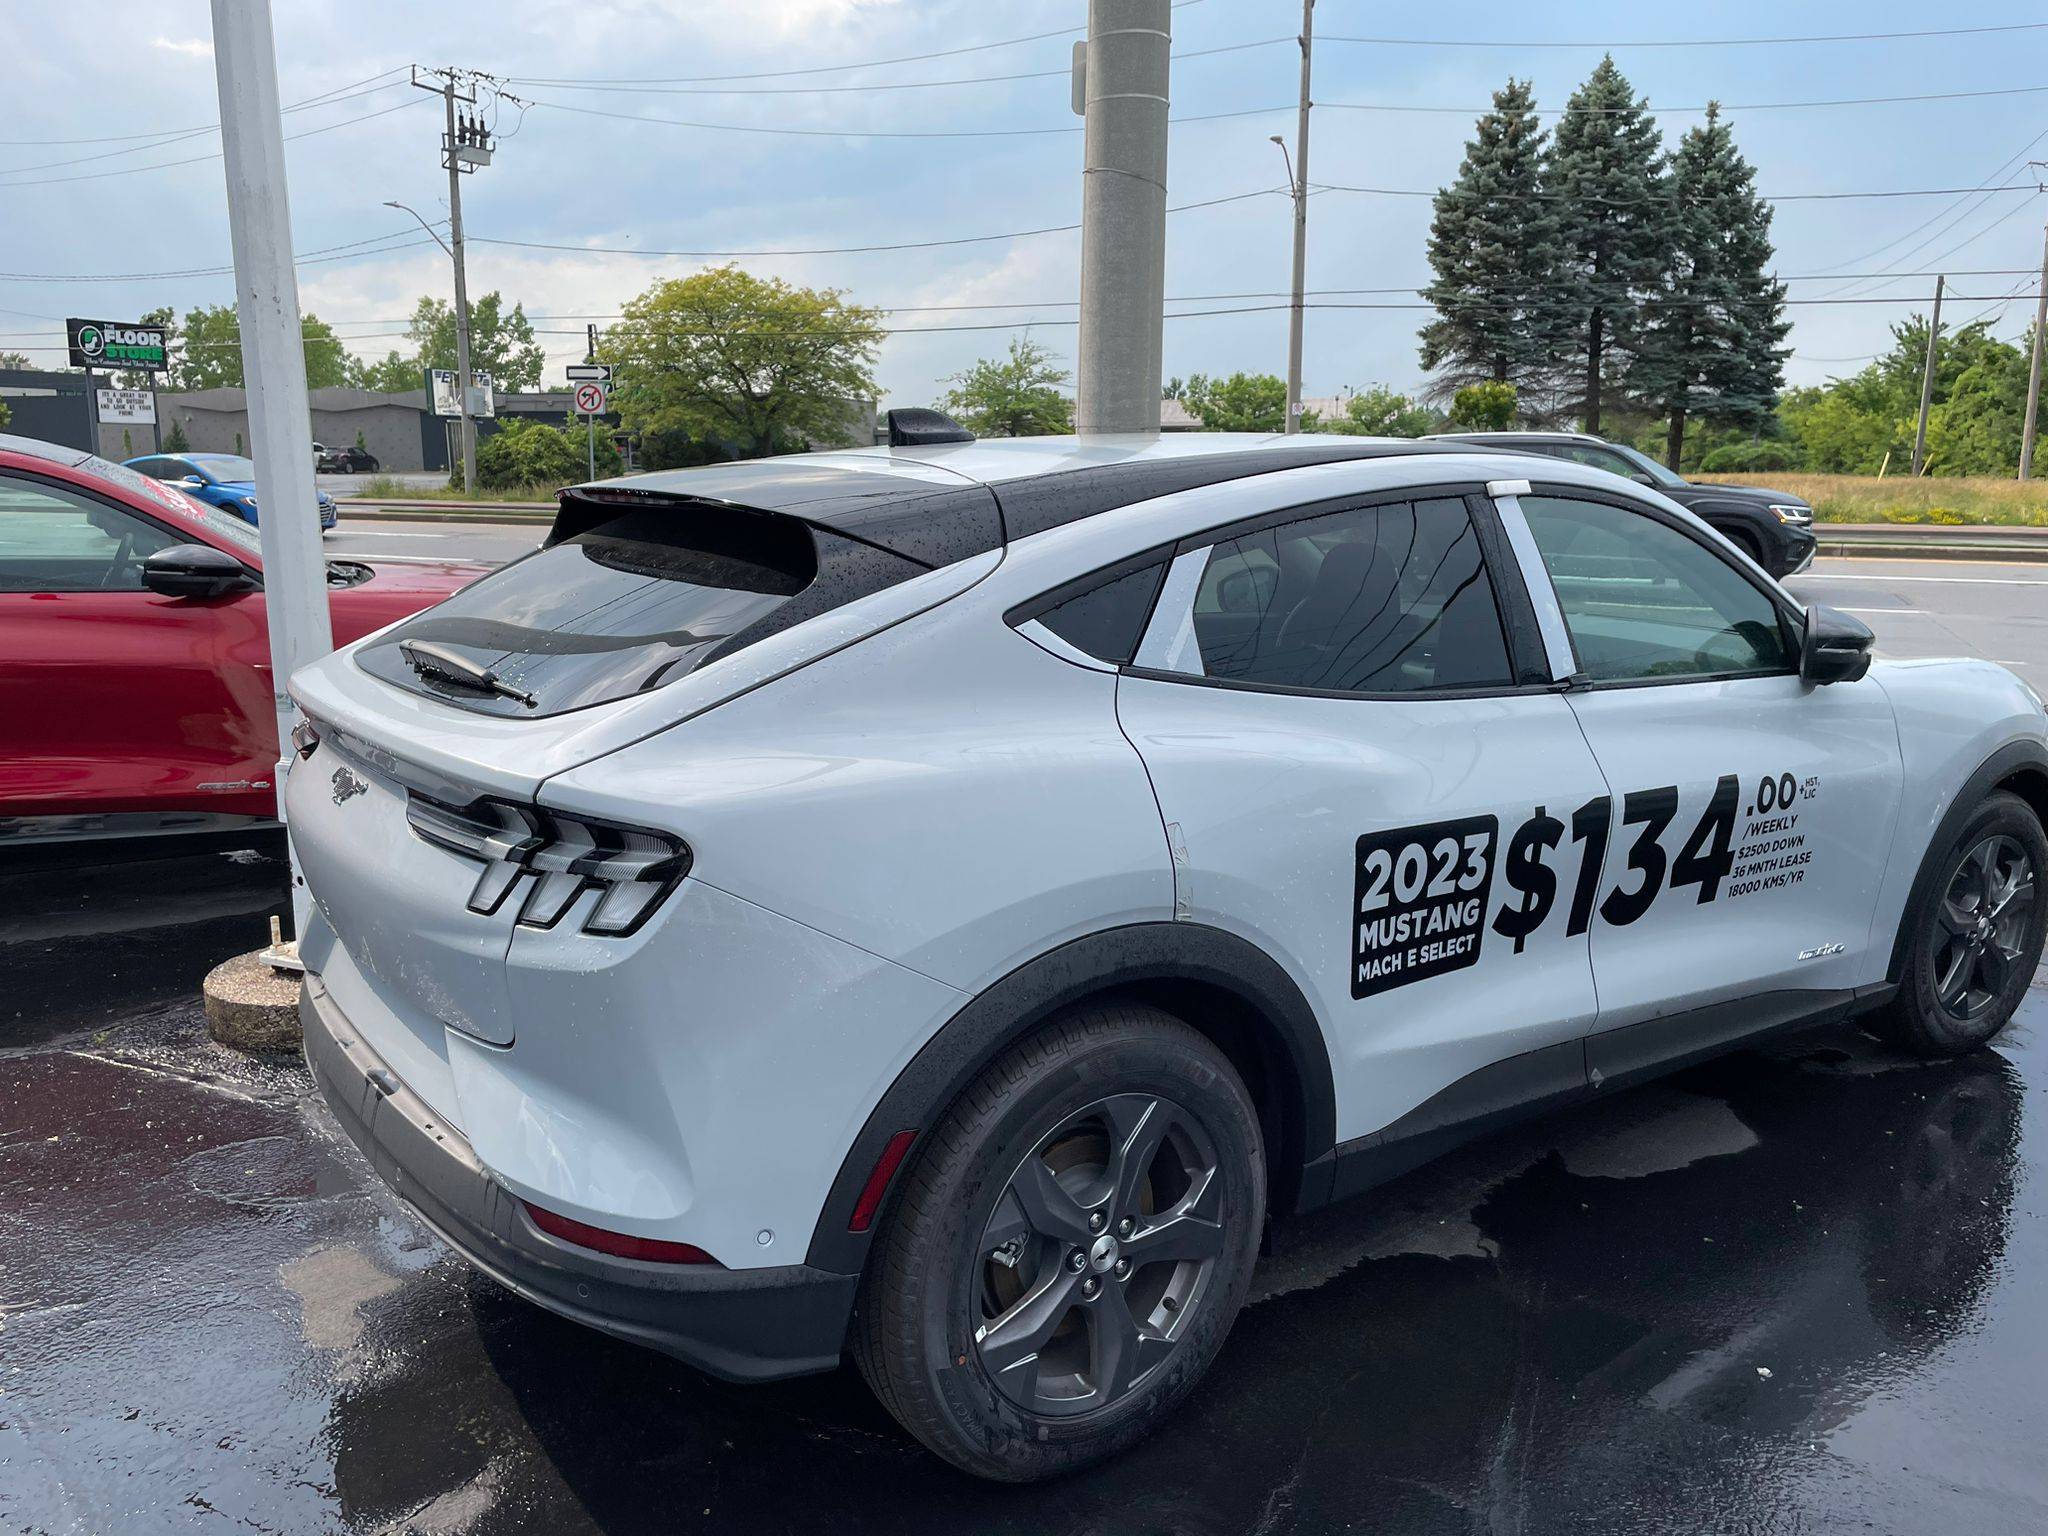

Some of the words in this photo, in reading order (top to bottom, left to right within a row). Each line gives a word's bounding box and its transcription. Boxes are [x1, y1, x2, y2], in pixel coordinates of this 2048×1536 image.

[104, 329, 162, 346] FLOOR
[106, 343, 163, 360] STORE
[1803, 788, 1817, 800] LIC
[1771, 835, 1806, 852] DOWN
[1360, 832, 1491, 913] 2023
[1732, 865, 1746, 879] 36
[1746, 858, 1778, 876] MNTH
[1779, 851, 1813, 869] LEASE
[1728, 880, 1760, 898] 18000
[1762, 870, 1805, 890] KMS/YR
[1359, 898, 1481, 954] MUSTANG
[1358, 952, 1402, 983] MACH
[1407, 946, 1418, 967] E
[1420, 933, 1476, 964] SELECT
